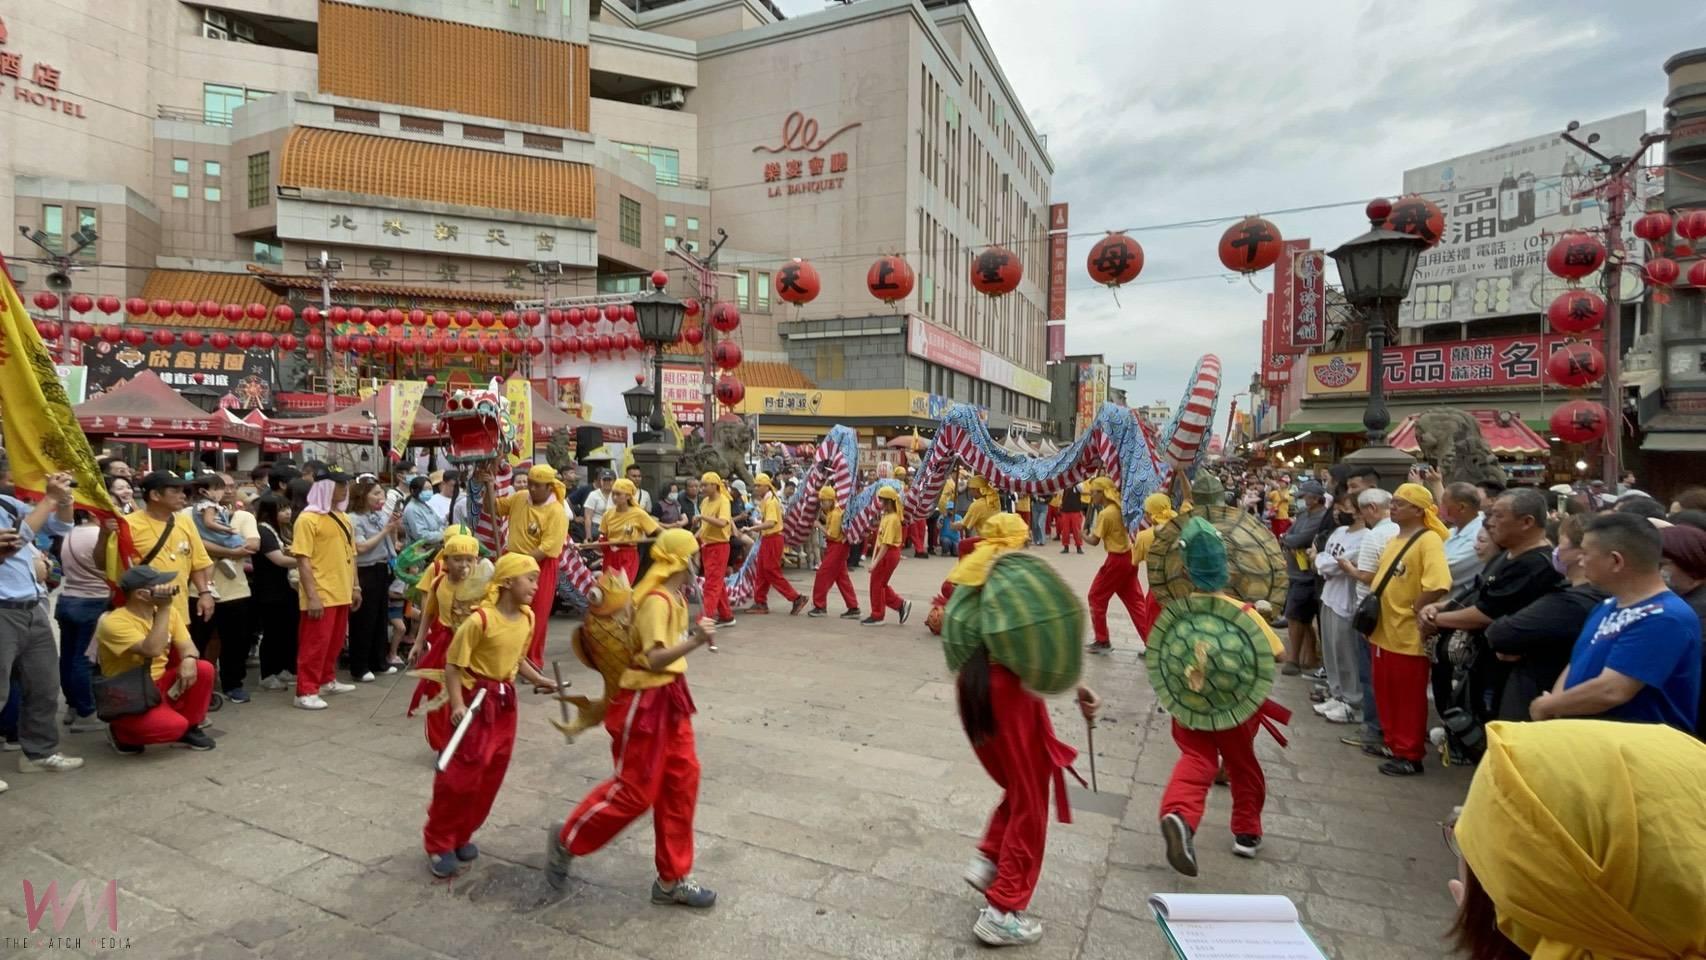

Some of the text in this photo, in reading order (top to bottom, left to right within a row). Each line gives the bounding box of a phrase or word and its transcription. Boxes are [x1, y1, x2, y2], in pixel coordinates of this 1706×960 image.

[15, 86, 87, 119] HOTEL
[787, 177, 845, 196] BANQUET
[330, 213, 556, 252] 北港朝天宮
[1231, 224, 1274, 263] 千
[870, 260, 900, 291] 上
[1092, 243, 1136, 277] 母
[779, 264, 809, 294] 天
